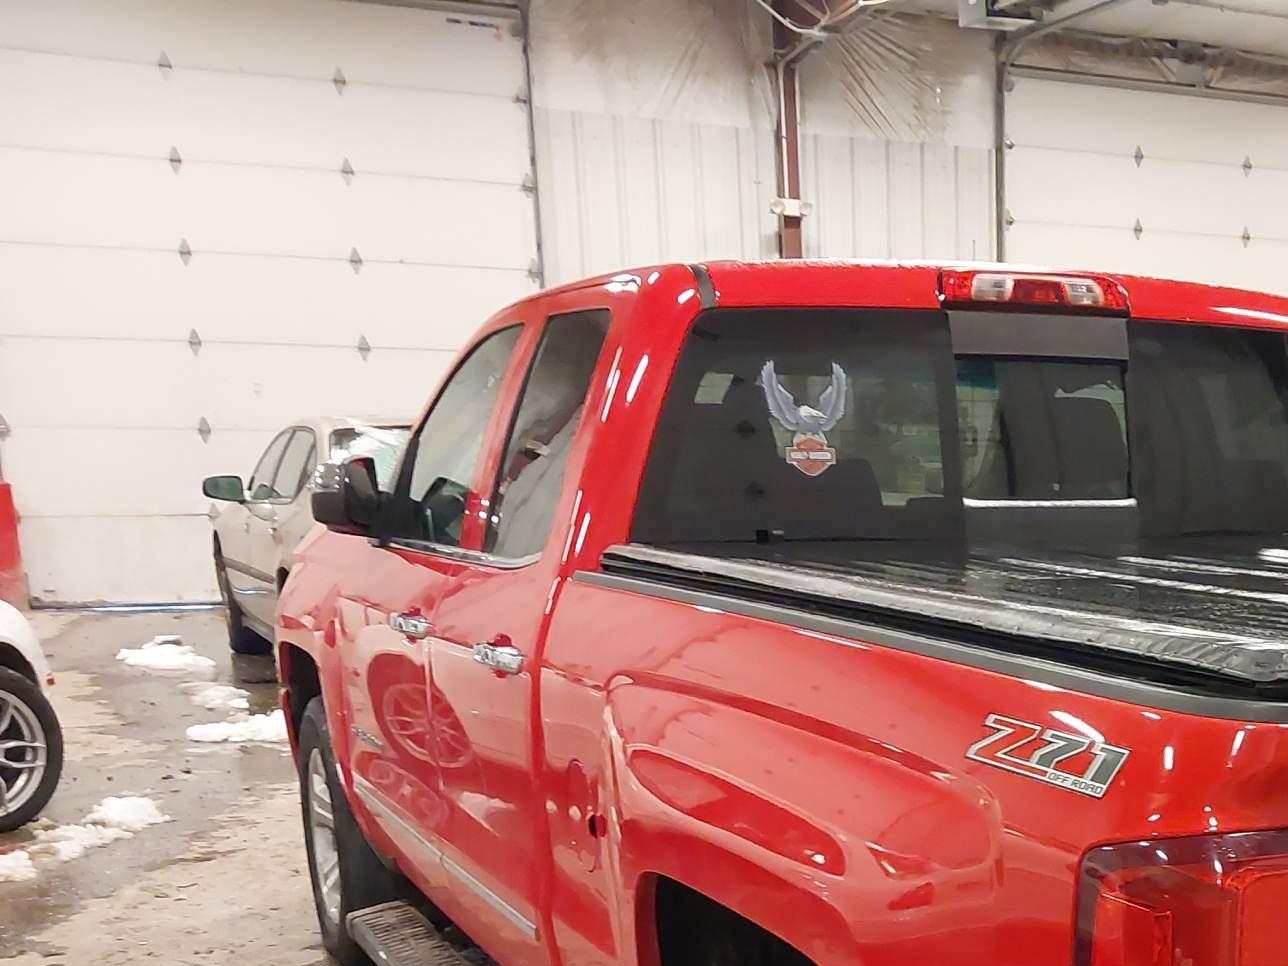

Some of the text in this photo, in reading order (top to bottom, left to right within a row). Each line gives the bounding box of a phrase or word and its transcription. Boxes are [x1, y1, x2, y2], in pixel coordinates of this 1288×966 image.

[965, 712, 1132, 787] Z71
[1049, 771, 1104, 795] OFF ROAD
